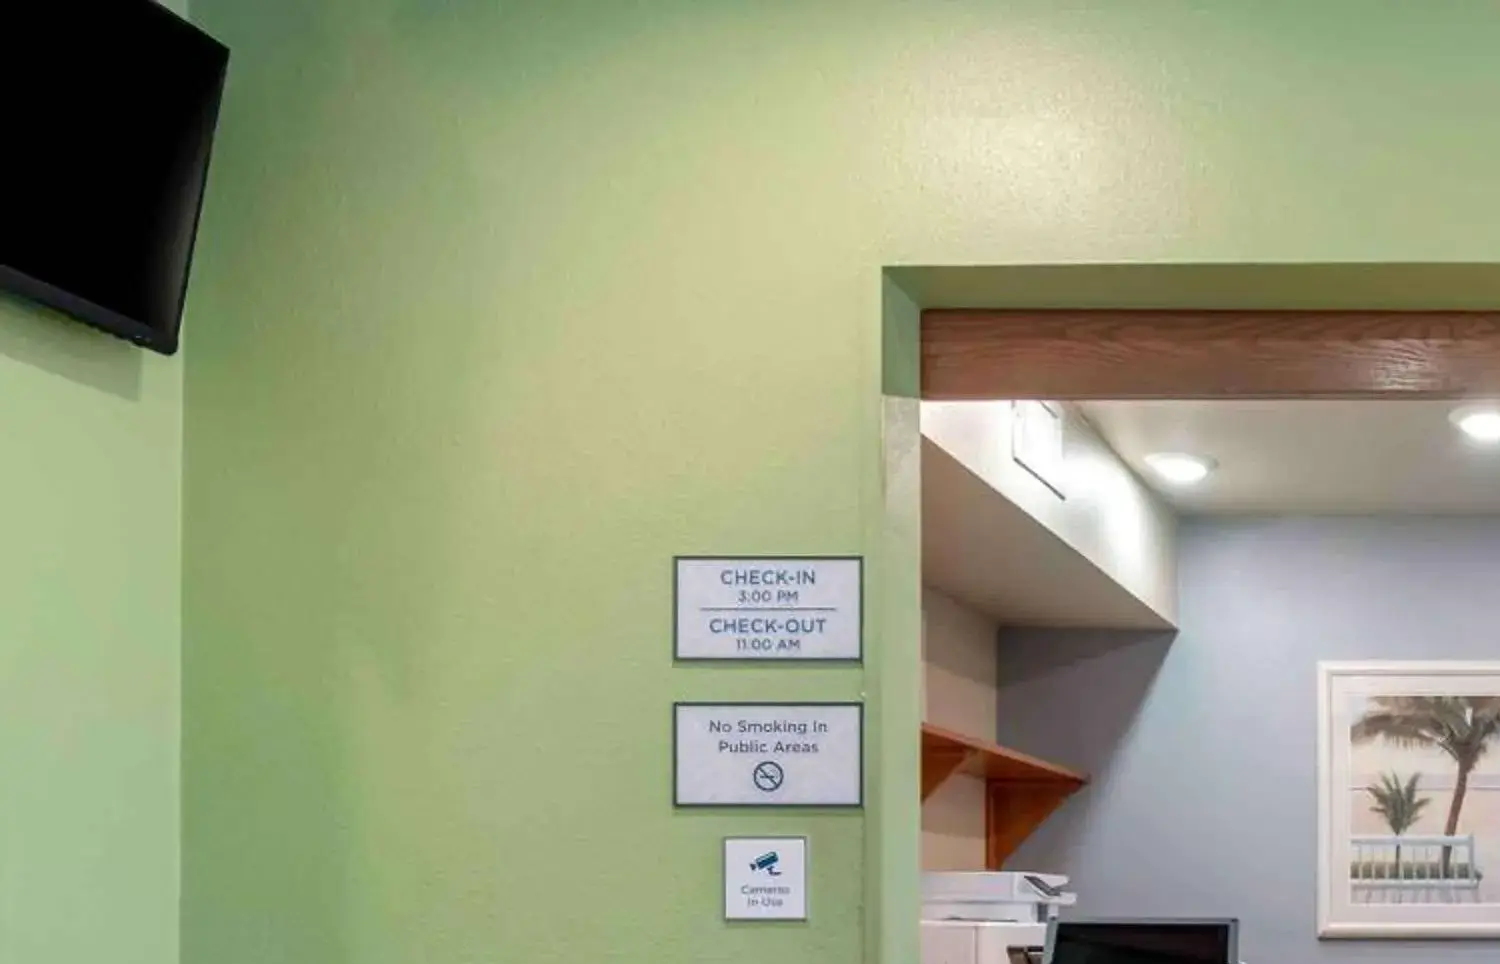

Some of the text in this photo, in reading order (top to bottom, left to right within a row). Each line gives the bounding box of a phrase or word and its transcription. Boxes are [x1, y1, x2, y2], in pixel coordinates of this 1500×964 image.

[720, 569, 816, 585] CHECK-IN
[777, 590, 799, 602] PM
[709, 618, 827, 634] CHECK-OUT
[777, 639, 800, 650] AM
[709, 720, 828, 735] No Smoking In
[719, 741, 819, 753] Public Areas
